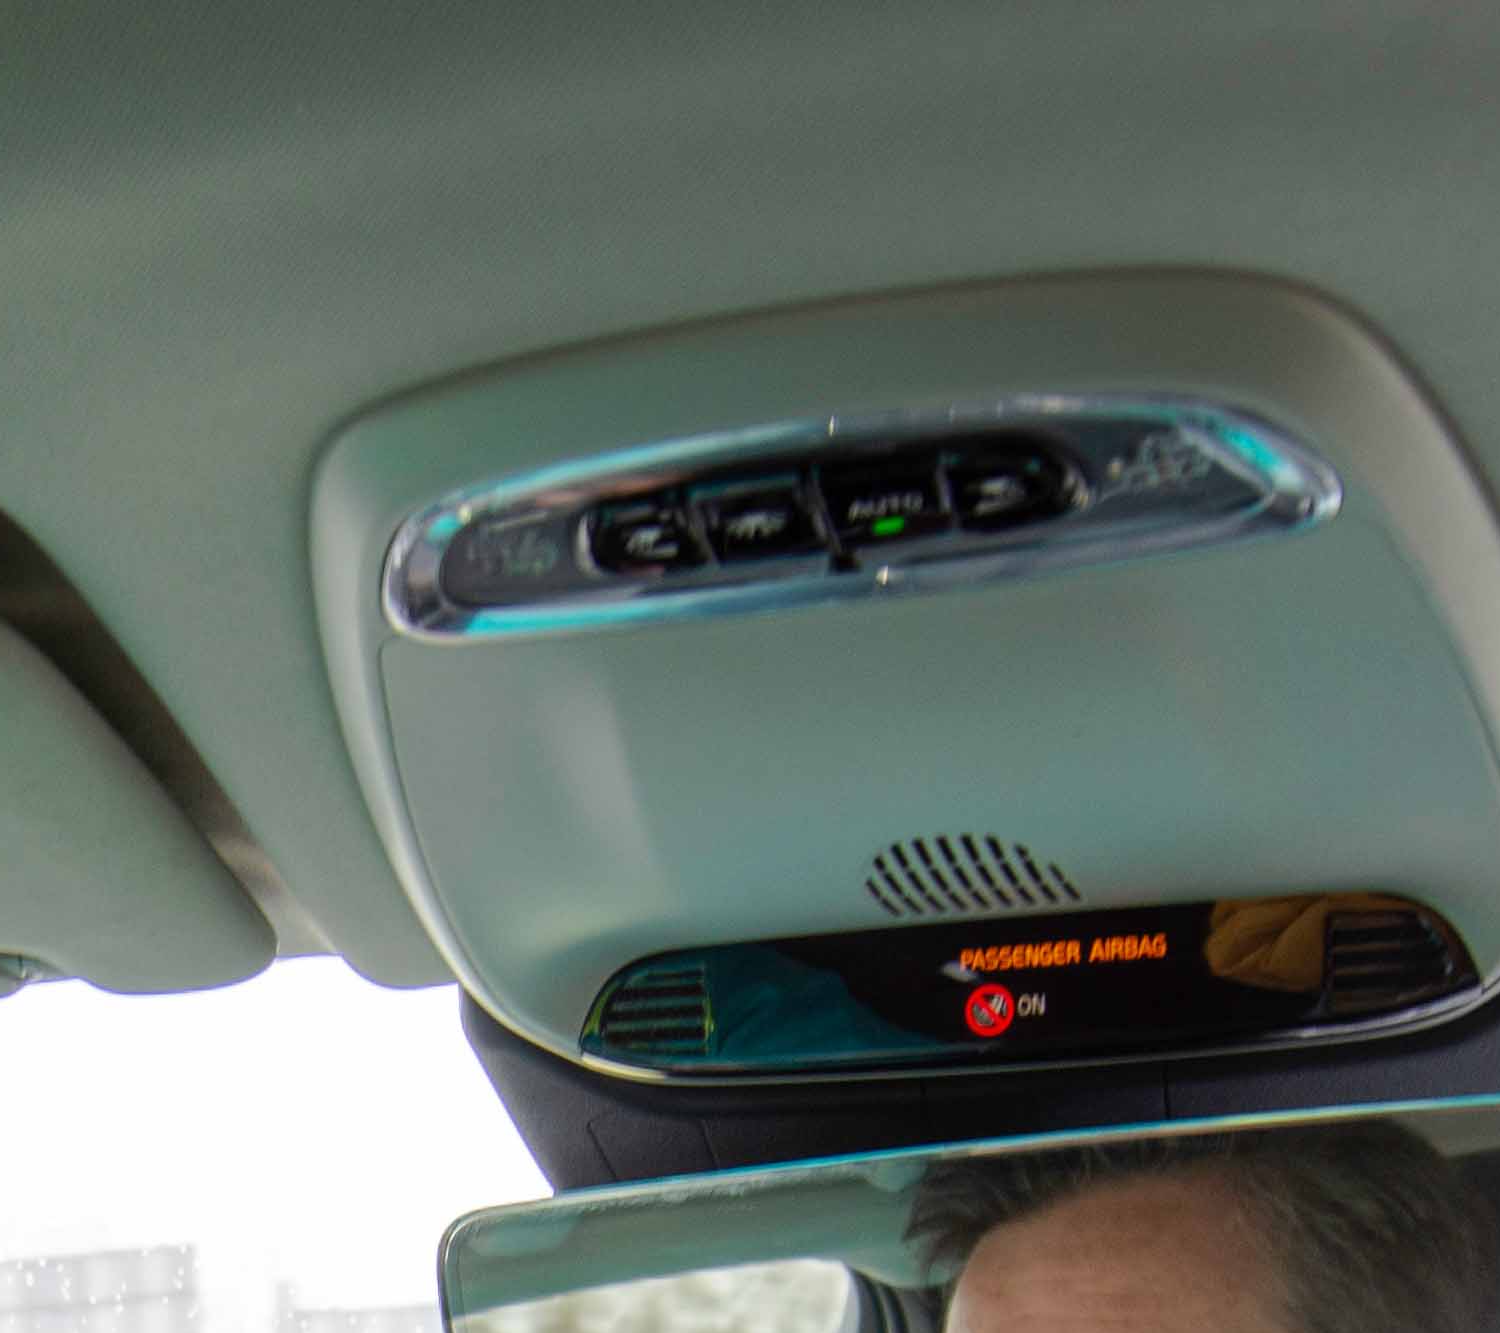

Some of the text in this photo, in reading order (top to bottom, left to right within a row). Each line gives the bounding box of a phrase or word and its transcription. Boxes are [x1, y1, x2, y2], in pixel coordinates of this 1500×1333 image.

[959, 932, 1168, 971] PASSENGER AIRBAG
[1017, 993, 1046, 1017] ON
